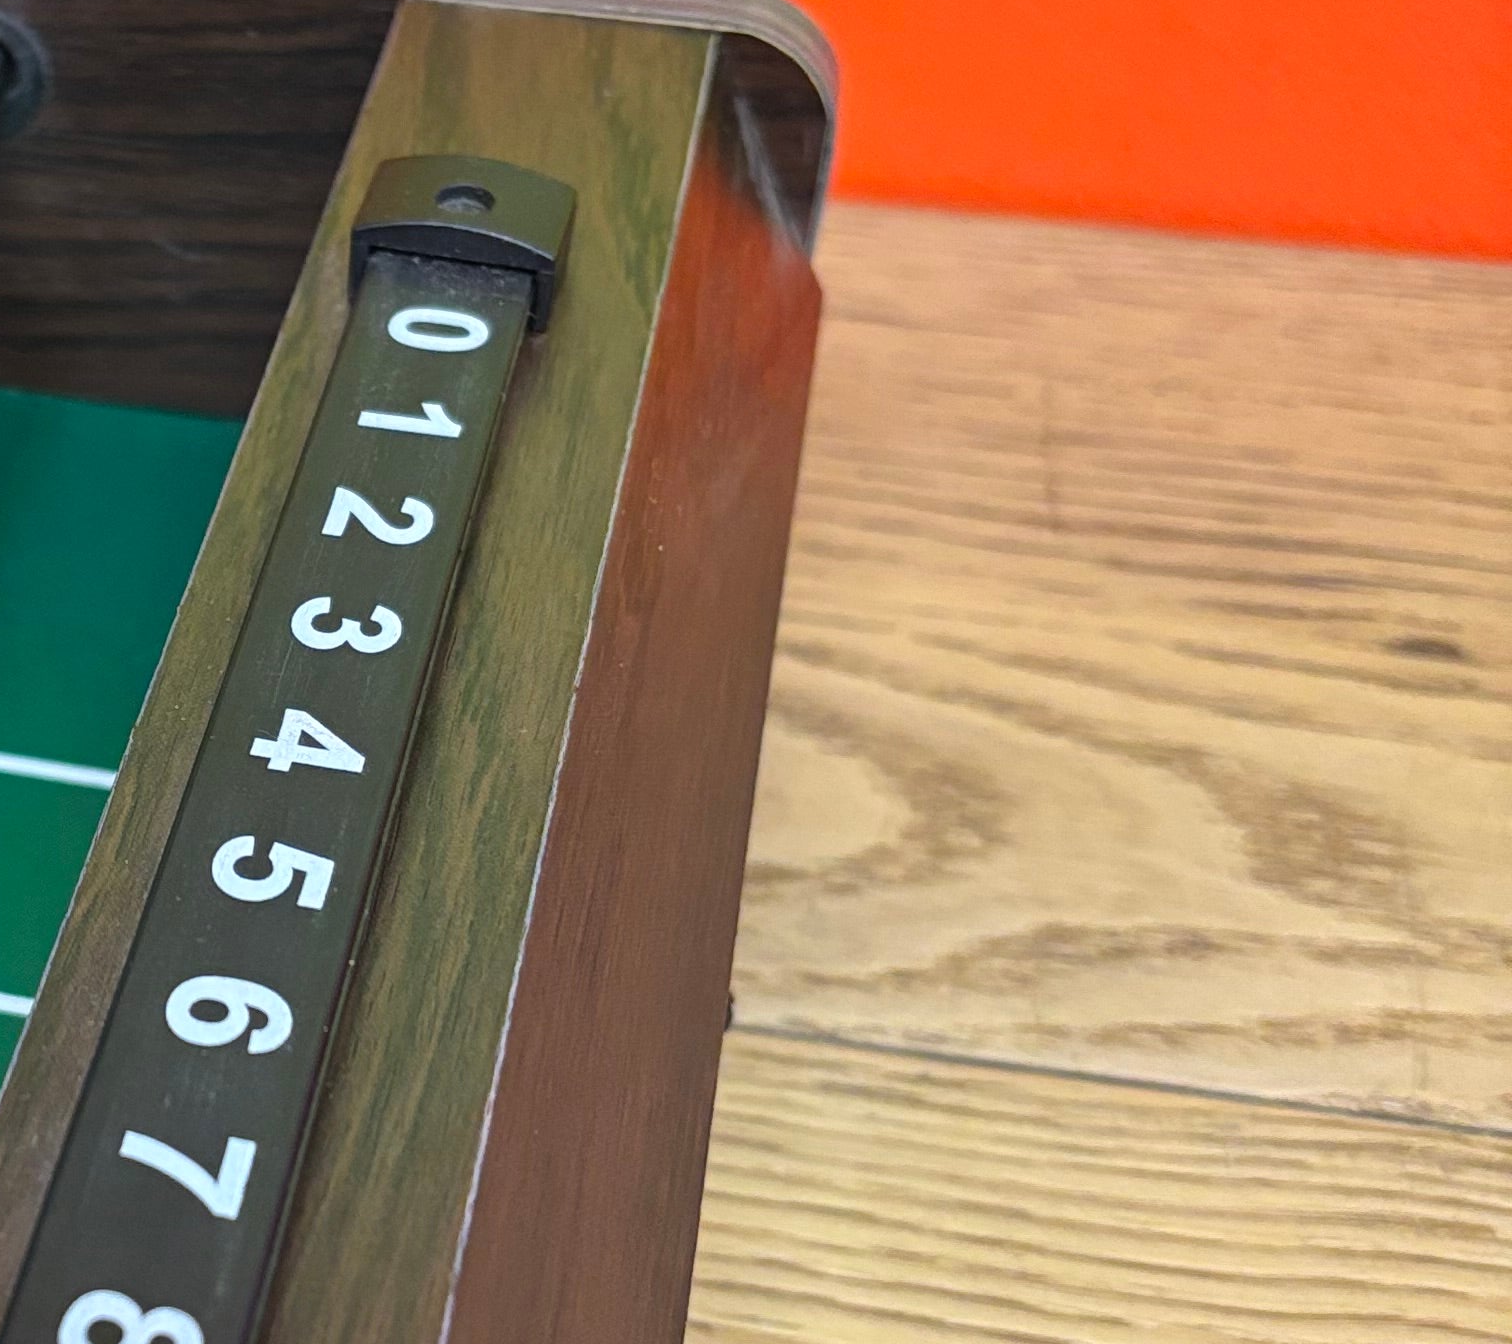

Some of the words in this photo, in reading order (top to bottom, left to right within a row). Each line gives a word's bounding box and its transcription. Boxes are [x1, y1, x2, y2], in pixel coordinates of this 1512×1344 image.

[388, 307, 490, 352] 0
[358, 402, 463, 438] 1
[322, 487, 434, 544] 2
[291, 597, 402, 653] 3
[250, 708, 365, 773] 4
[212, 836, 335, 910] 5
[166, 976, 293, 1054] 6
[119, 1131, 256, 1220] 7
